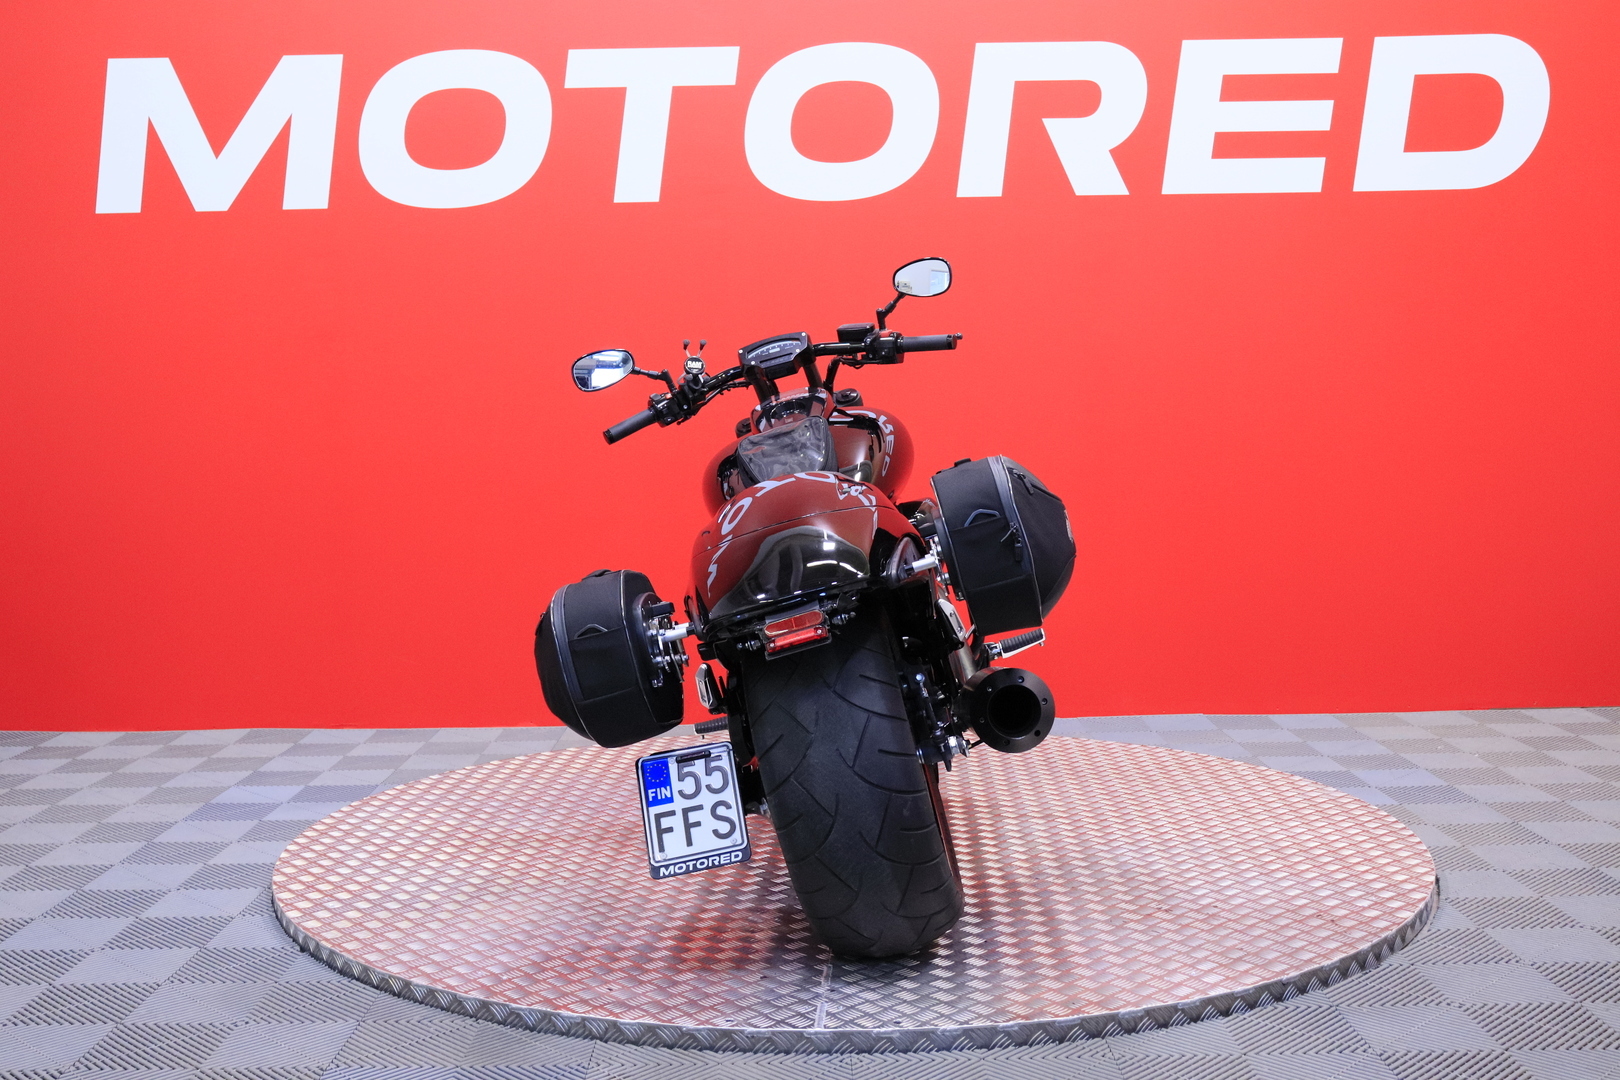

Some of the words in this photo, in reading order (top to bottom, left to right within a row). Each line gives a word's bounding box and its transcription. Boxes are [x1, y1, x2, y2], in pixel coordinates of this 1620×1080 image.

[95, 33, 1551, 214] MOTORED
[648, 786, 671, 801] FIN
[677, 754, 729, 800] 55
[654, 800, 736, 853] FFS
[660, 852, 742, 876] MOTORED
